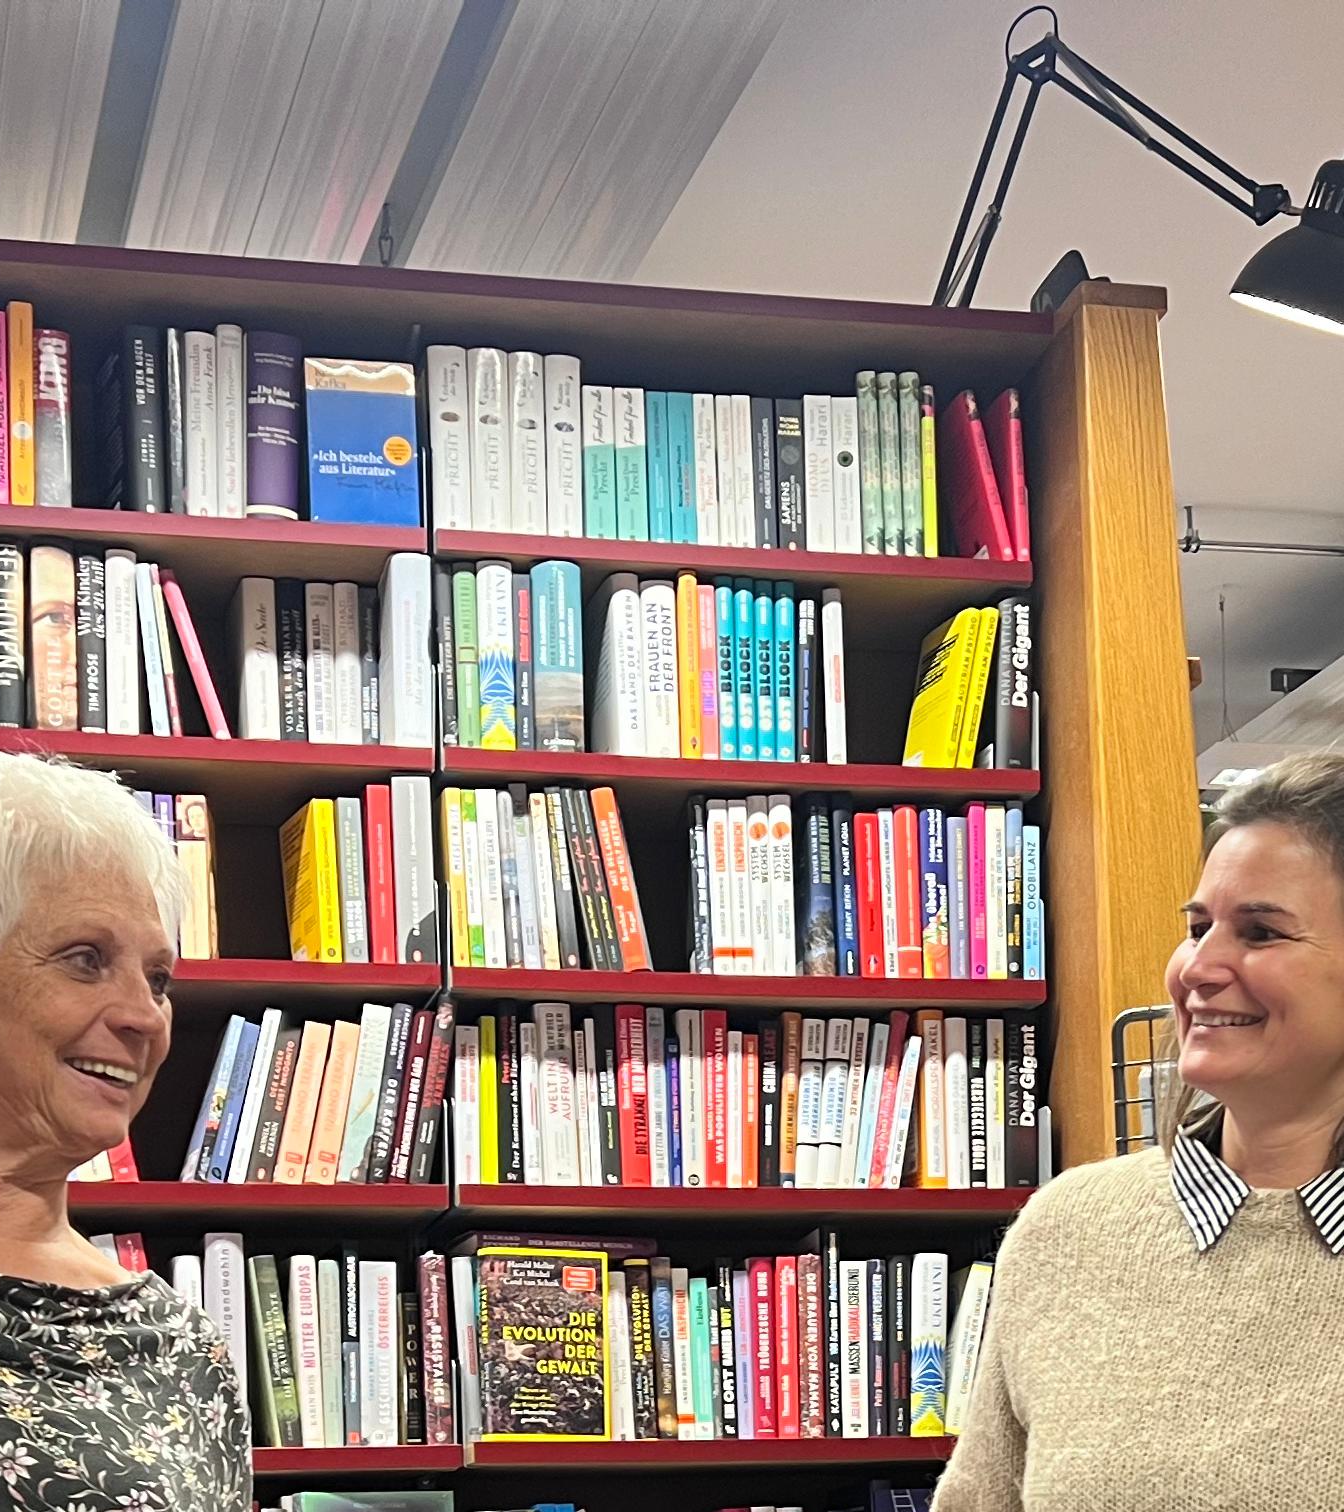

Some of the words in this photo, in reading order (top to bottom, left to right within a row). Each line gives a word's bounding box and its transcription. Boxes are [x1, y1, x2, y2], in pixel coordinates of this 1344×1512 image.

[190, 344, 201, 396] Freundin
[192, 399, 202, 432] Meine
[816, 404, 827, 447] Harari
[319, 465, 339, 476] aus
[336, 451, 384, 466] bestehe
[448, 431, 460, 488] PRECHT
[487, 433, 499, 491] PRECHT
[527, 436, 539, 495] PRECHT
[563, 440, 574, 498] PRECHT
[599, 461, 608, 494] Precht
[629, 463, 639, 497] Precht
[781, 481, 791, 525] SAPIENS
[76, 557, 92, 609] Kinder
[625, 594, 634, 640] BAYERN
[646, 602, 657, 627] AN
[660, 605, 673, 663] FRONT
[1012, 604, 1031, 675] Gigant
[648, 634, 660, 692] FRAUEN
[664, 667, 674, 692] DER
[720, 635, 731, 693] BLOCK
[739, 636, 751, 694] BLOCK
[758, 639, 771, 696] BLOCK
[779, 640, 790, 697] BLOCK
[87, 691, 98, 713] TIM
[285, 690, 295, 733] VOLKER
[1001, 671, 1010, 706] DANA
[1011, 676, 1028, 708] Der
[346, 900, 356, 943] WERNER
[354, 900, 363, 942] HERZOG
[714, 1027, 725, 1075] WOLLEN
[1020, 1024, 1037, 1089] Gigant
[549, 1085, 559, 1115] WELT
[561, 1057, 571, 1121] AUFRUHR
[715, 1079, 726, 1142] POPULISTEN
[1019, 1091, 1035, 1127] Der
[374, 1108, 393, 1159] KOFFER
[510, 1106, 519, 1148] Kontinent
[633, 1094, 646, 1134] TYRANNEI
[636, 1135, 648, 1156] DIE
[298, 1265, 313, 1318] EUROPAS
[377, 1274, 390, 1349] ÖSTERREICHS
[502, 1326, 596, 1342] EVOLUTION
[569, 1312, 596, 1327] DIE
[632, 1285, 642, 1346] EVOLUTION
[303, 1322, 315, 1368] MÜTTER
[406, 1324, 419, 1400] POWER
[536, 1360, 598, 1376] GEWALT
[564, 1344, 596, 1359] DER
[830, 1362, 840, 1414] KATAPULT
